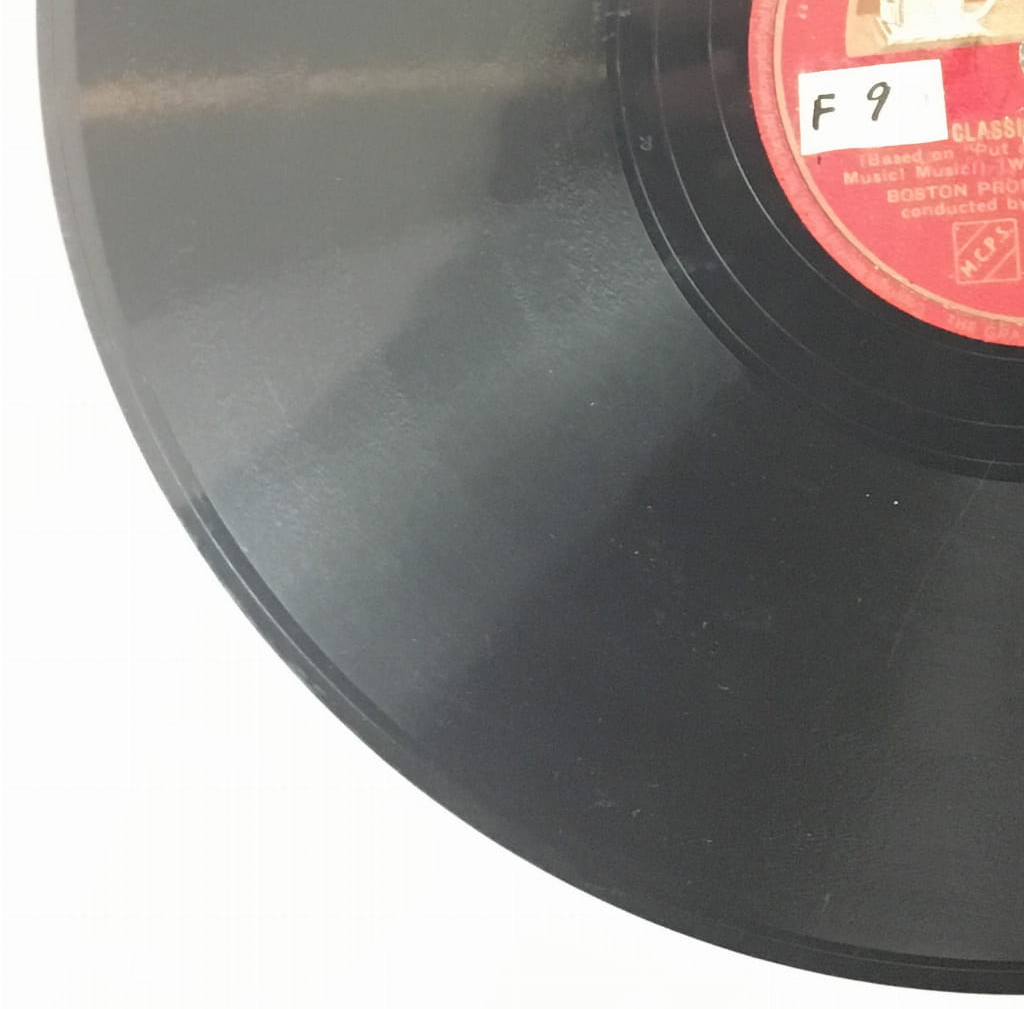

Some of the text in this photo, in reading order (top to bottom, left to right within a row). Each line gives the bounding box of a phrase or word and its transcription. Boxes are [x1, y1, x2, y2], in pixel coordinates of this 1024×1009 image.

[812, 81, 891, 131] F 9
[931, 148, 955, 161] on
[886, 184, 969, 204] BOSTON
[900, 197, 998, 220] conducted
